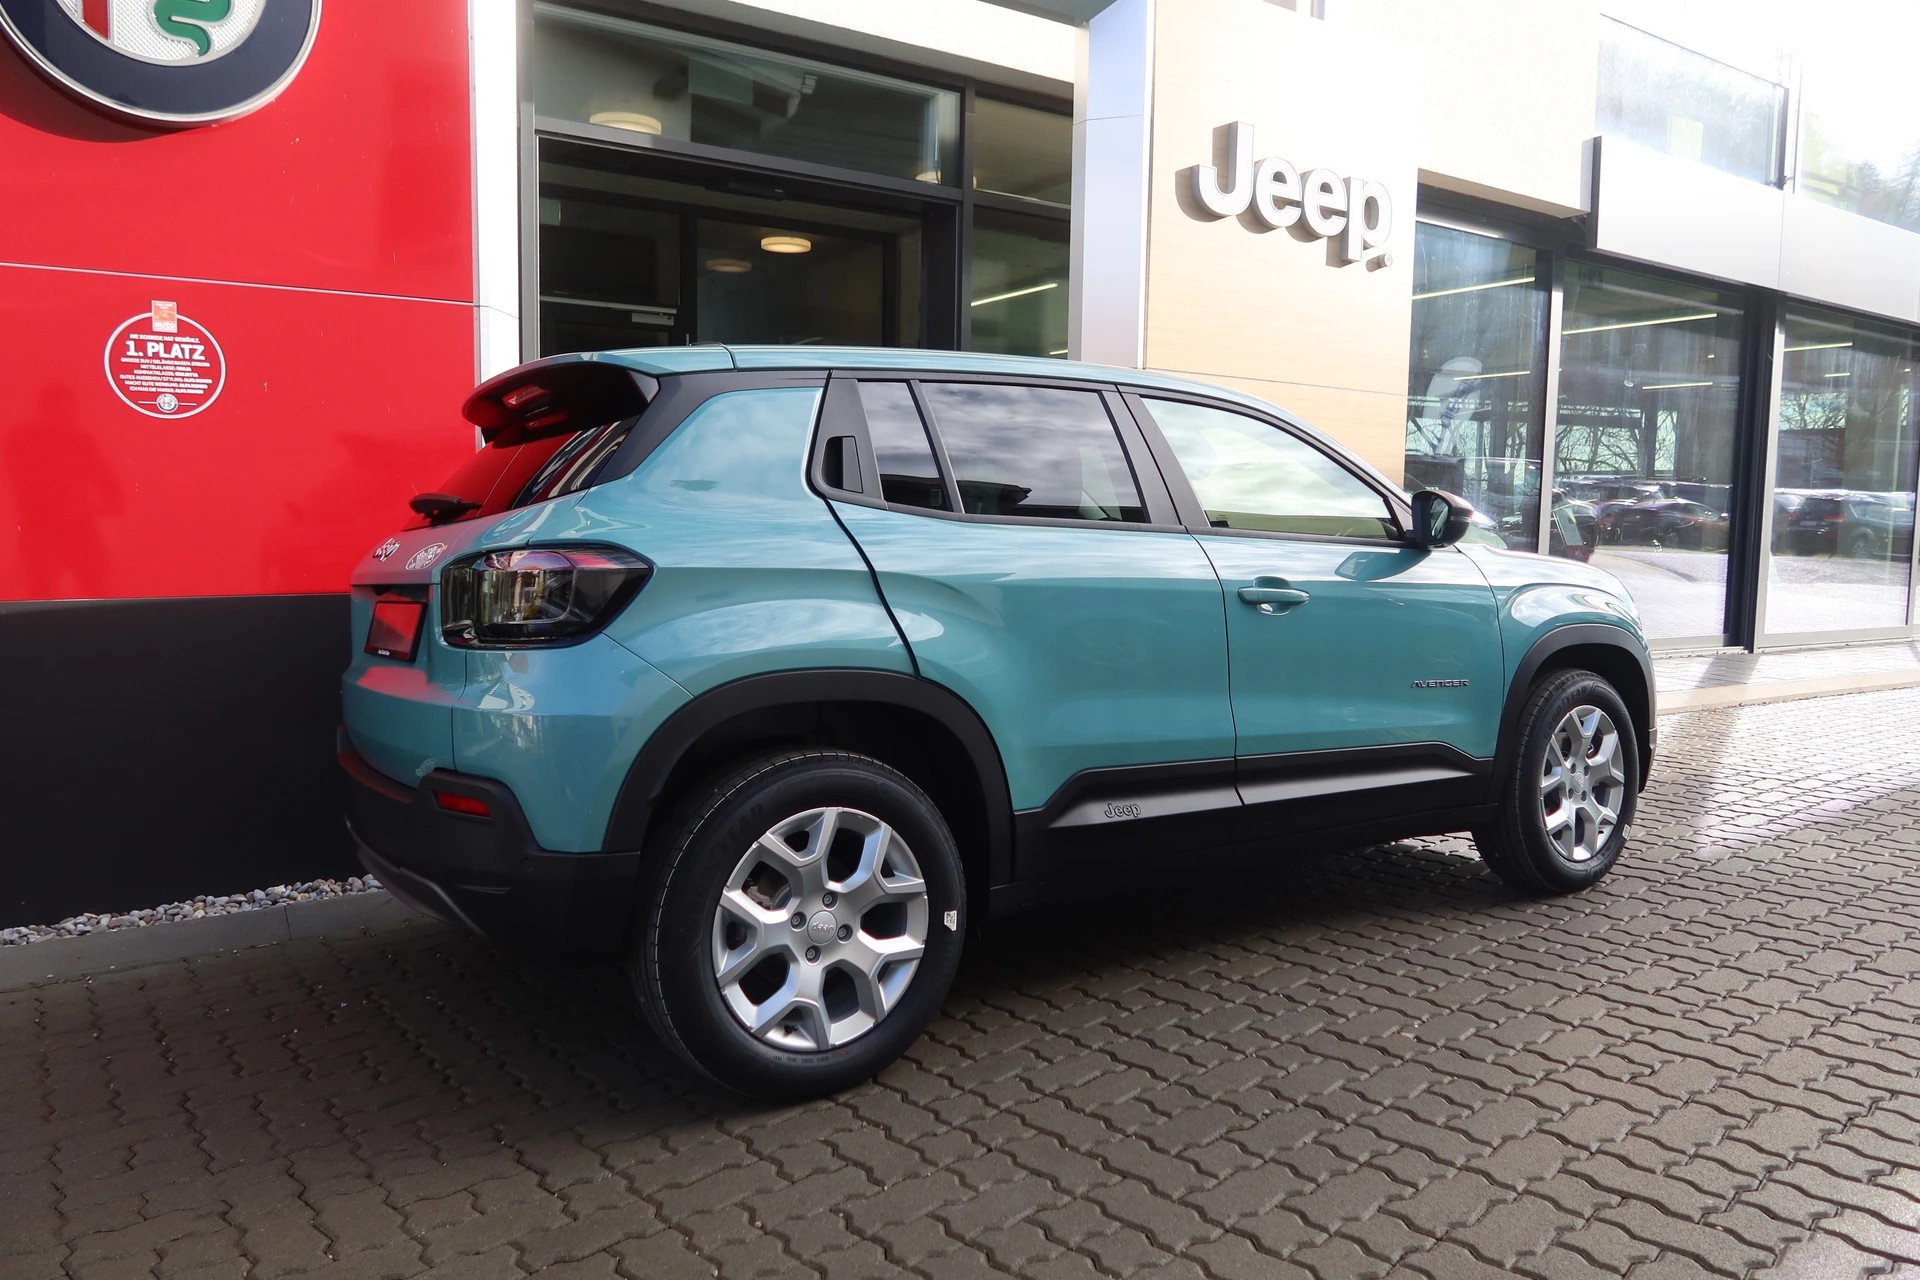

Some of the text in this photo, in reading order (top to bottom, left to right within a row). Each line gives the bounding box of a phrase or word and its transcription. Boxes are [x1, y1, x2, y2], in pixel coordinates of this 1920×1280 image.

[1180, 120, 1393, 265] Jeep
[126, 340, 205, 360] 1. PLATZ
[1411, 678, 1470, 688] AVENGER
[1104, 802, 1142, 819] Jeep
[811, 921, 834, 935] Jeep
